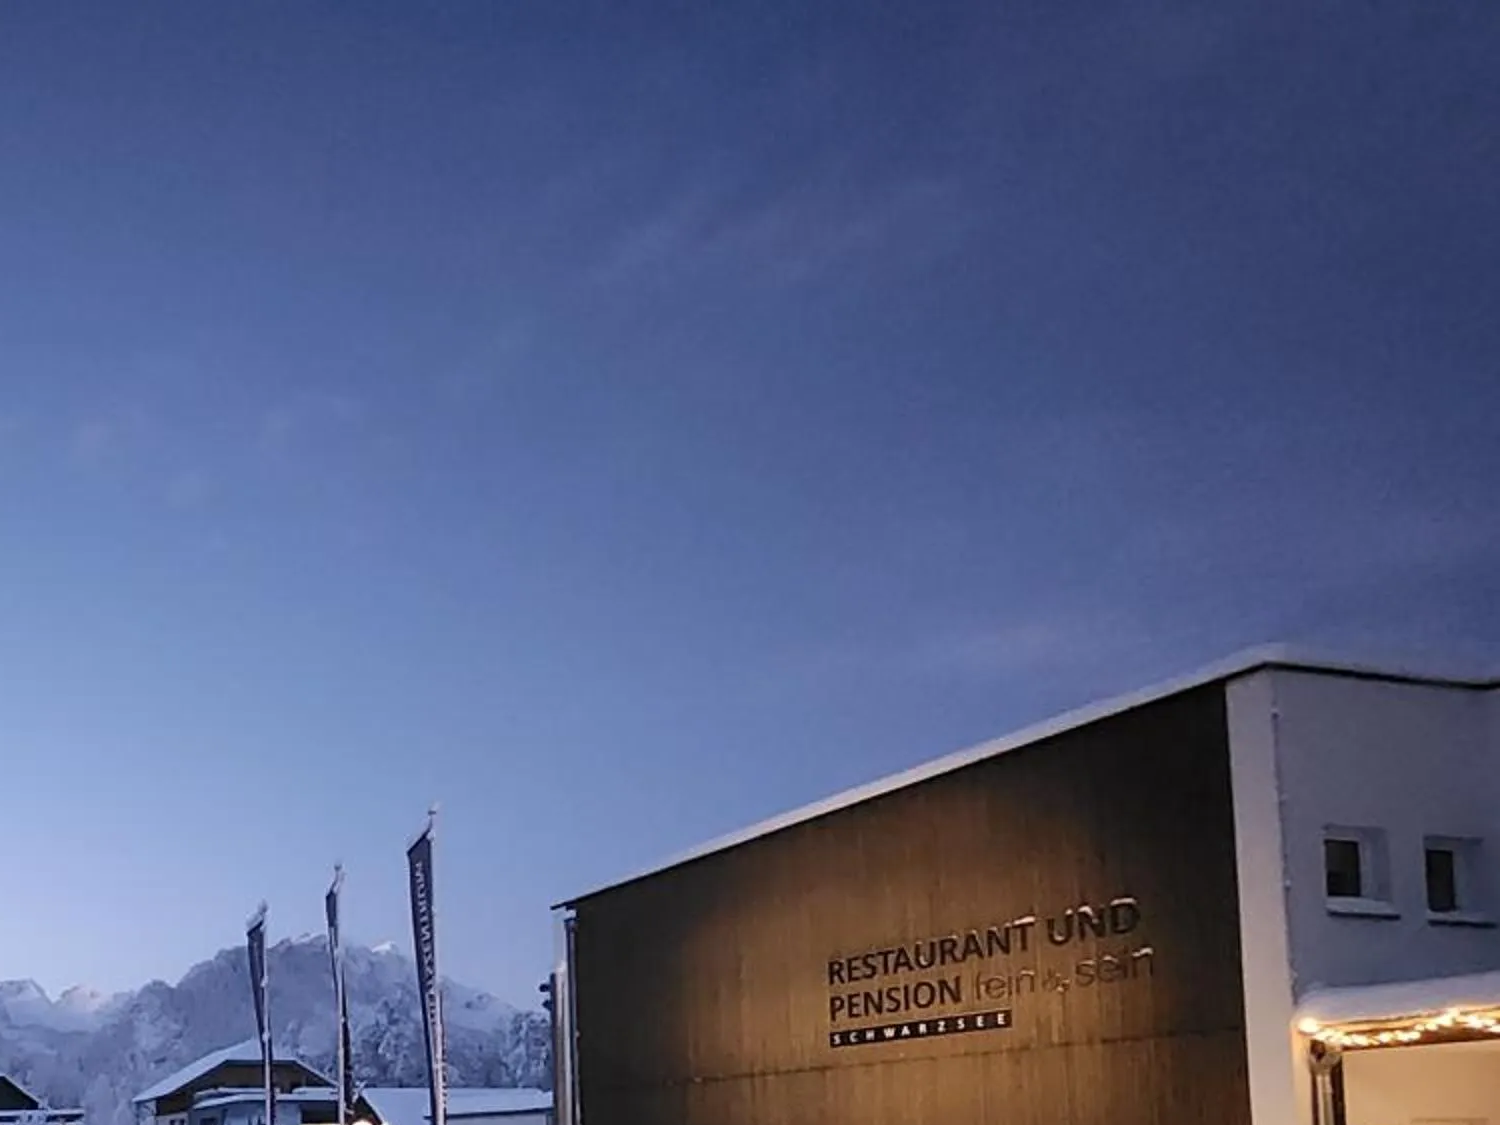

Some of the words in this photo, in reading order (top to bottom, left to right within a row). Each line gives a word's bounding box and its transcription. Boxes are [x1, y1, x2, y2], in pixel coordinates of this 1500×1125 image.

[828, 916, 1036, 986] RESTAURANT
[1047, 898, 1140, 946] UND
[830, 975, 962, 1022] PENSION
[1075, 946, 1154, 988] sein
[833, 1013, 1007, 1046] SCHWARZSEE
